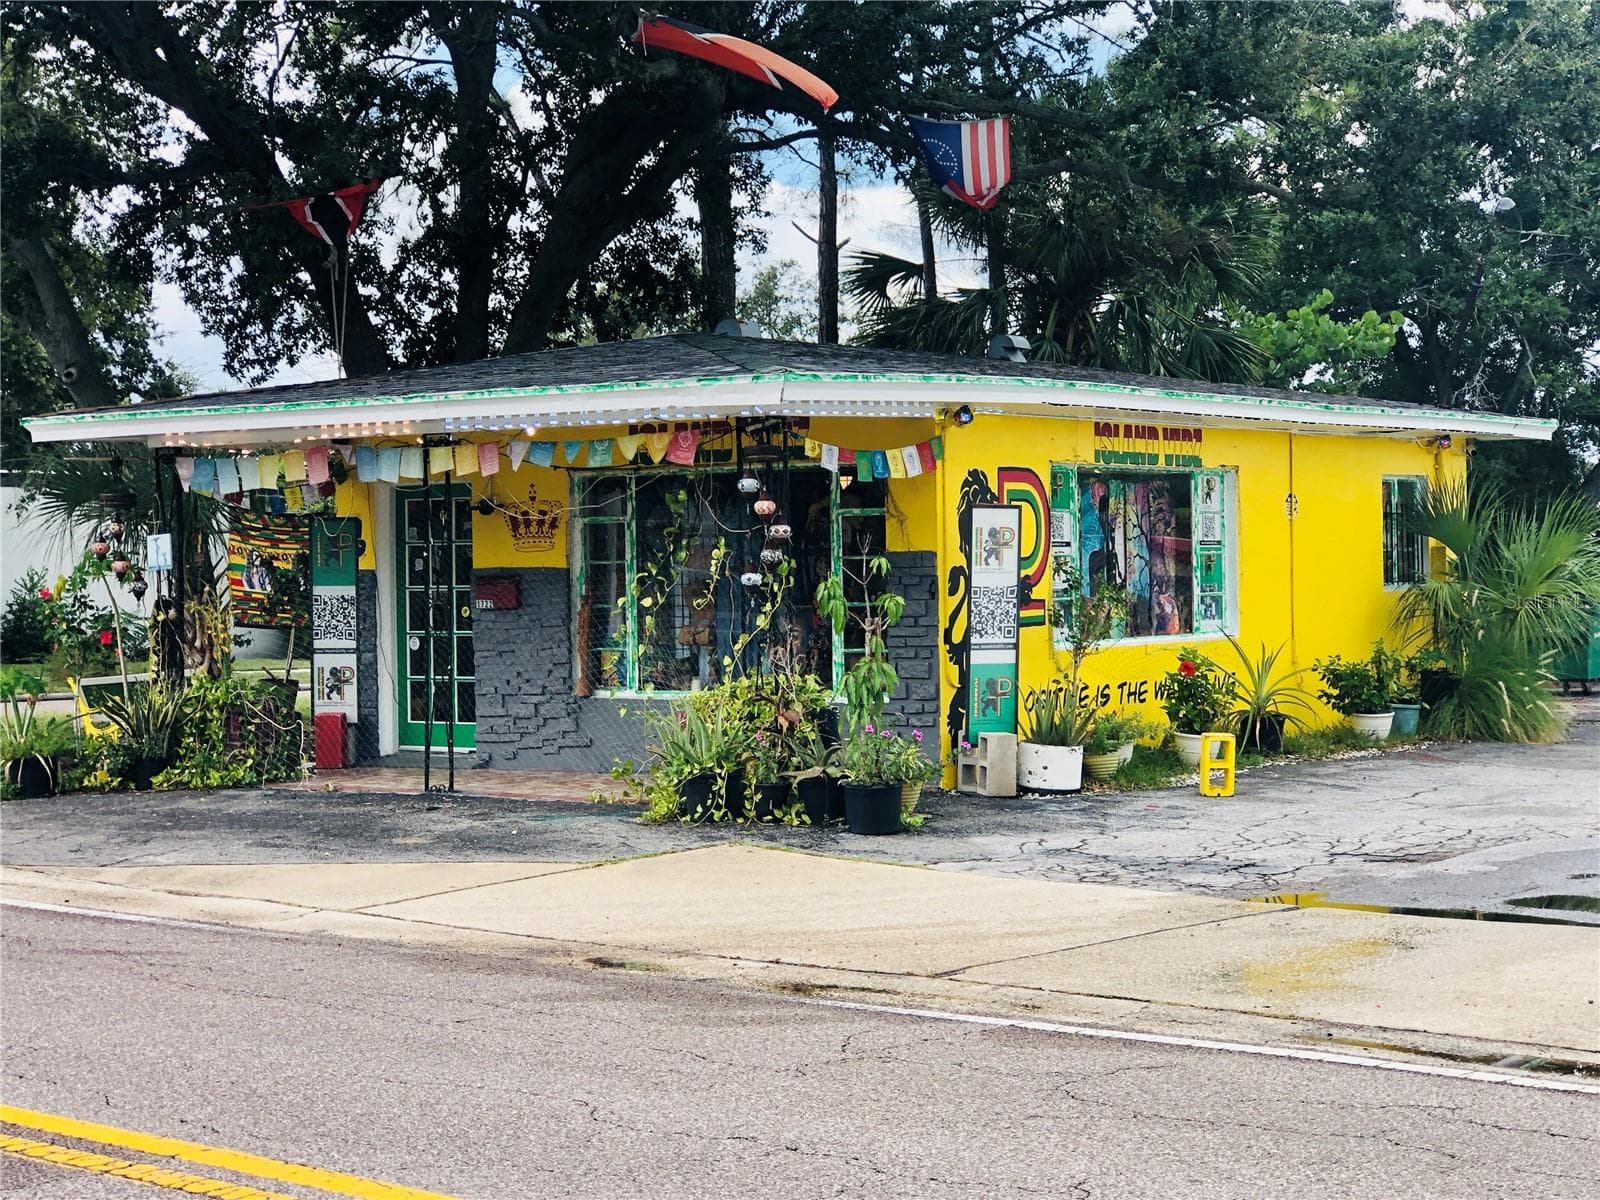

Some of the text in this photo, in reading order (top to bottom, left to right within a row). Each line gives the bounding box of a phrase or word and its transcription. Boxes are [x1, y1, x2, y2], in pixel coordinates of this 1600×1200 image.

[1094, 421, 1159, 465] ISLAND
[1094, 683, 1111, 708] IS
[1117, 679, 1148, 705] THE
